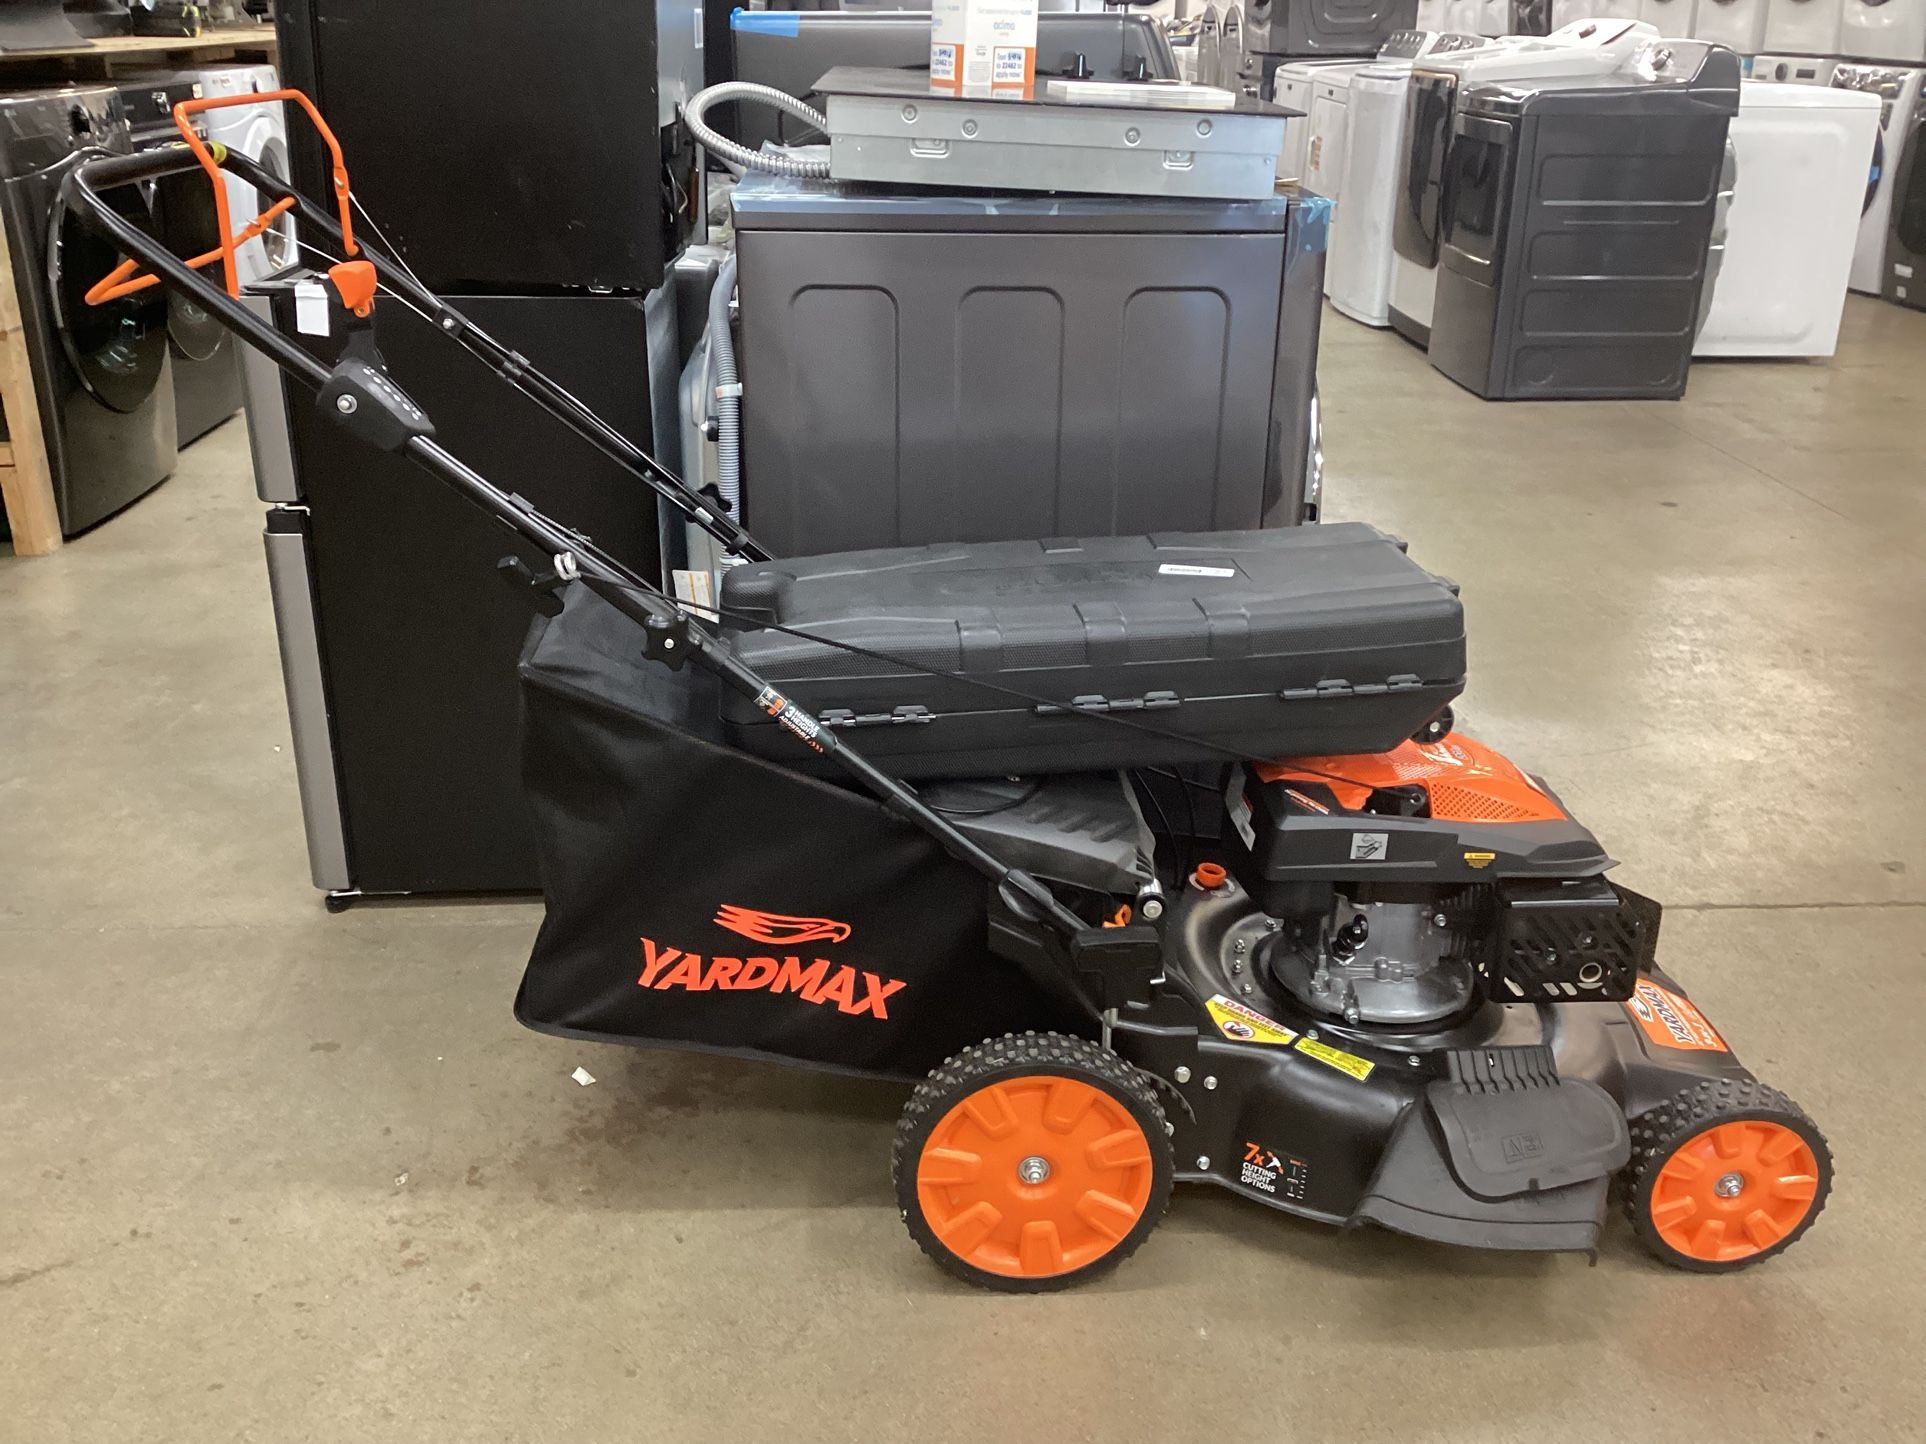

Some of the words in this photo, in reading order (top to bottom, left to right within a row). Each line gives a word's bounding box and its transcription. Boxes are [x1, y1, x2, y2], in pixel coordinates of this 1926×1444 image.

[785, 706, 796, 718] 3
[794, 710, 821, 731] HANDLE
[790, 715, 819, 738] HEIGHTS
[637, 937, 907, 1020] YARDMAX
[1223, 1000, 1287, 1031] DANGER
[1241, 1168, 1271, 1184] HEIGHT
[1242, 1162, 1277, 1180] CUTTING
[1240, 1175, 1276, 1193] OPTIONS
